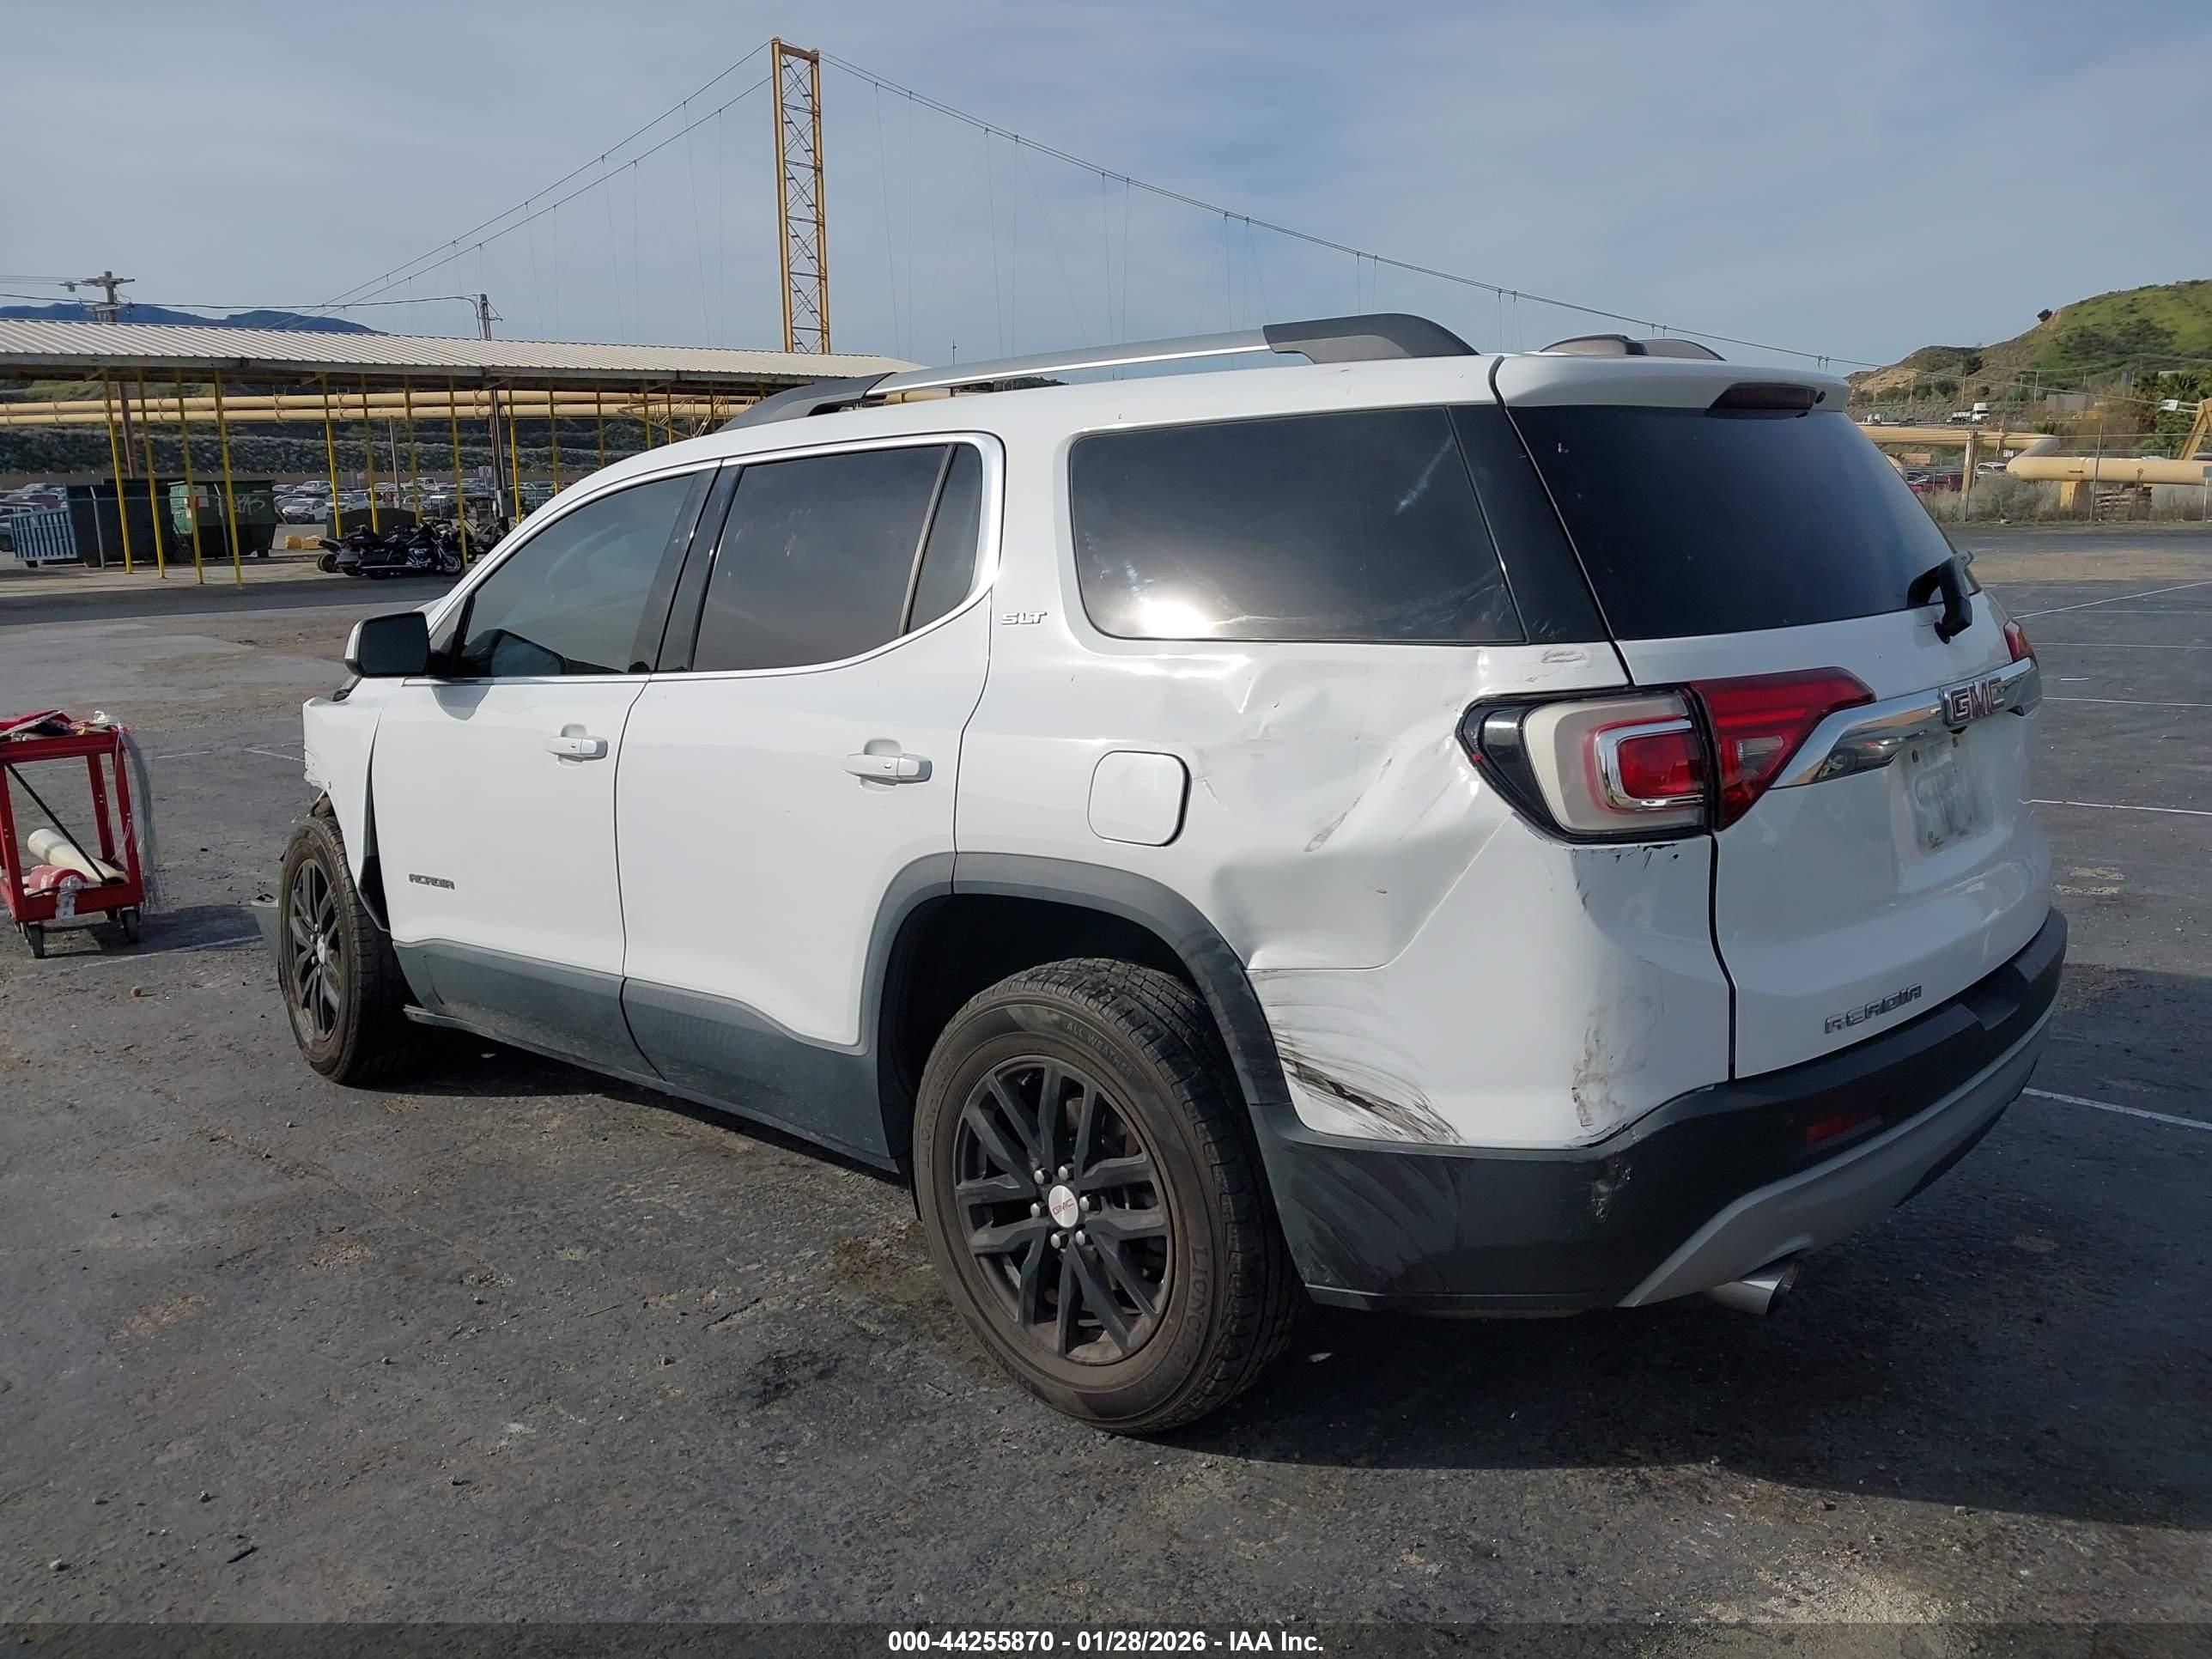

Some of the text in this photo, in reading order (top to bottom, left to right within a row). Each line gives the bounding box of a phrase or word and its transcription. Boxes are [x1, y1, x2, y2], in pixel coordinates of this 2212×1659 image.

[1000, 611, 1048, 626] SLT
[1949, 677, 2007, 723] GMC
[1824, 982, 1923, 1035] ACADIA
[1066, 1022, 1083, 1038] ALL
[1052, 1198, 1075, 1216] GMC
